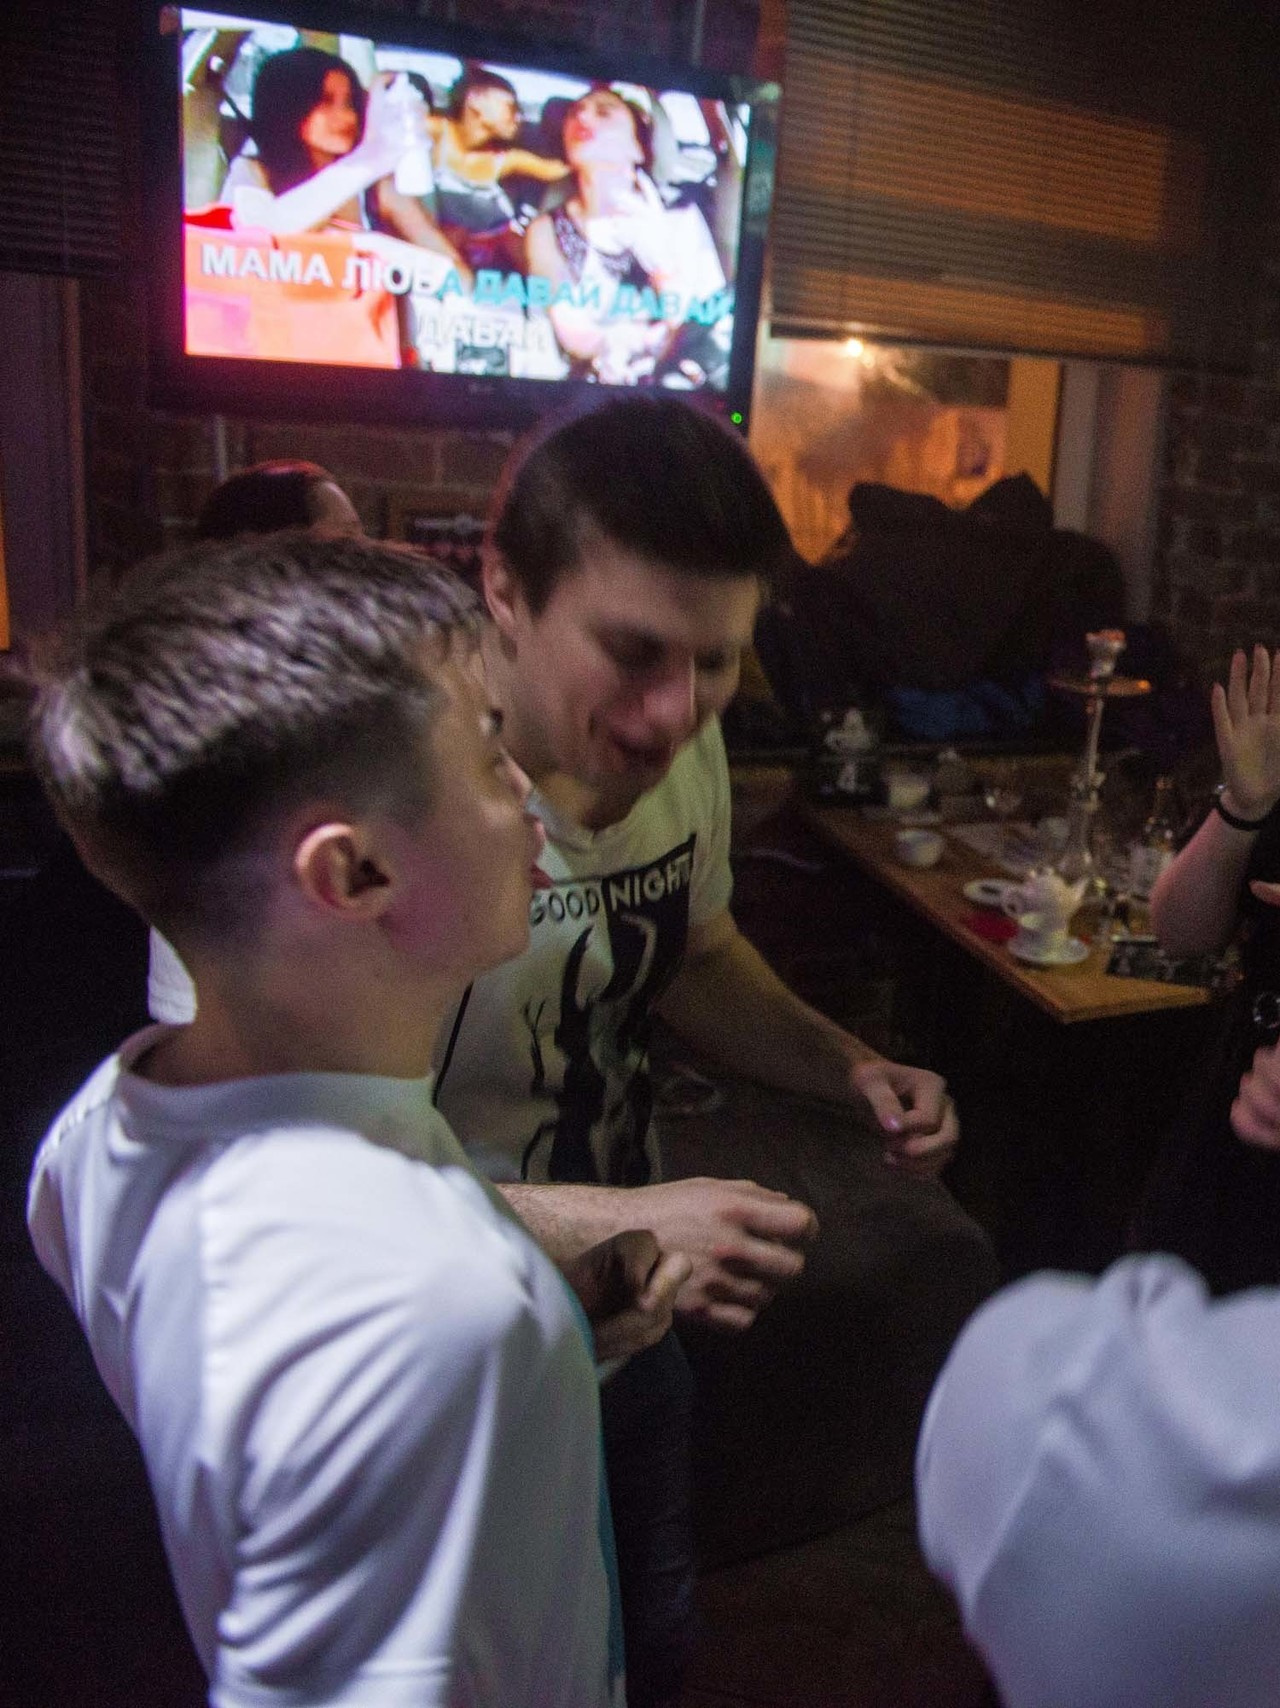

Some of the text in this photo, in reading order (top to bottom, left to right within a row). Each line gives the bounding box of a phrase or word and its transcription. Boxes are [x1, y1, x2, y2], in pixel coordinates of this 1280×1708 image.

[202, 243, 334, 288] МАМА
[341, 257, 463, 301] ЛЮБА
[473, 268, 602, 309] ДАВАЙ
[529, 849, 691, 927] GOOD NIGHT
